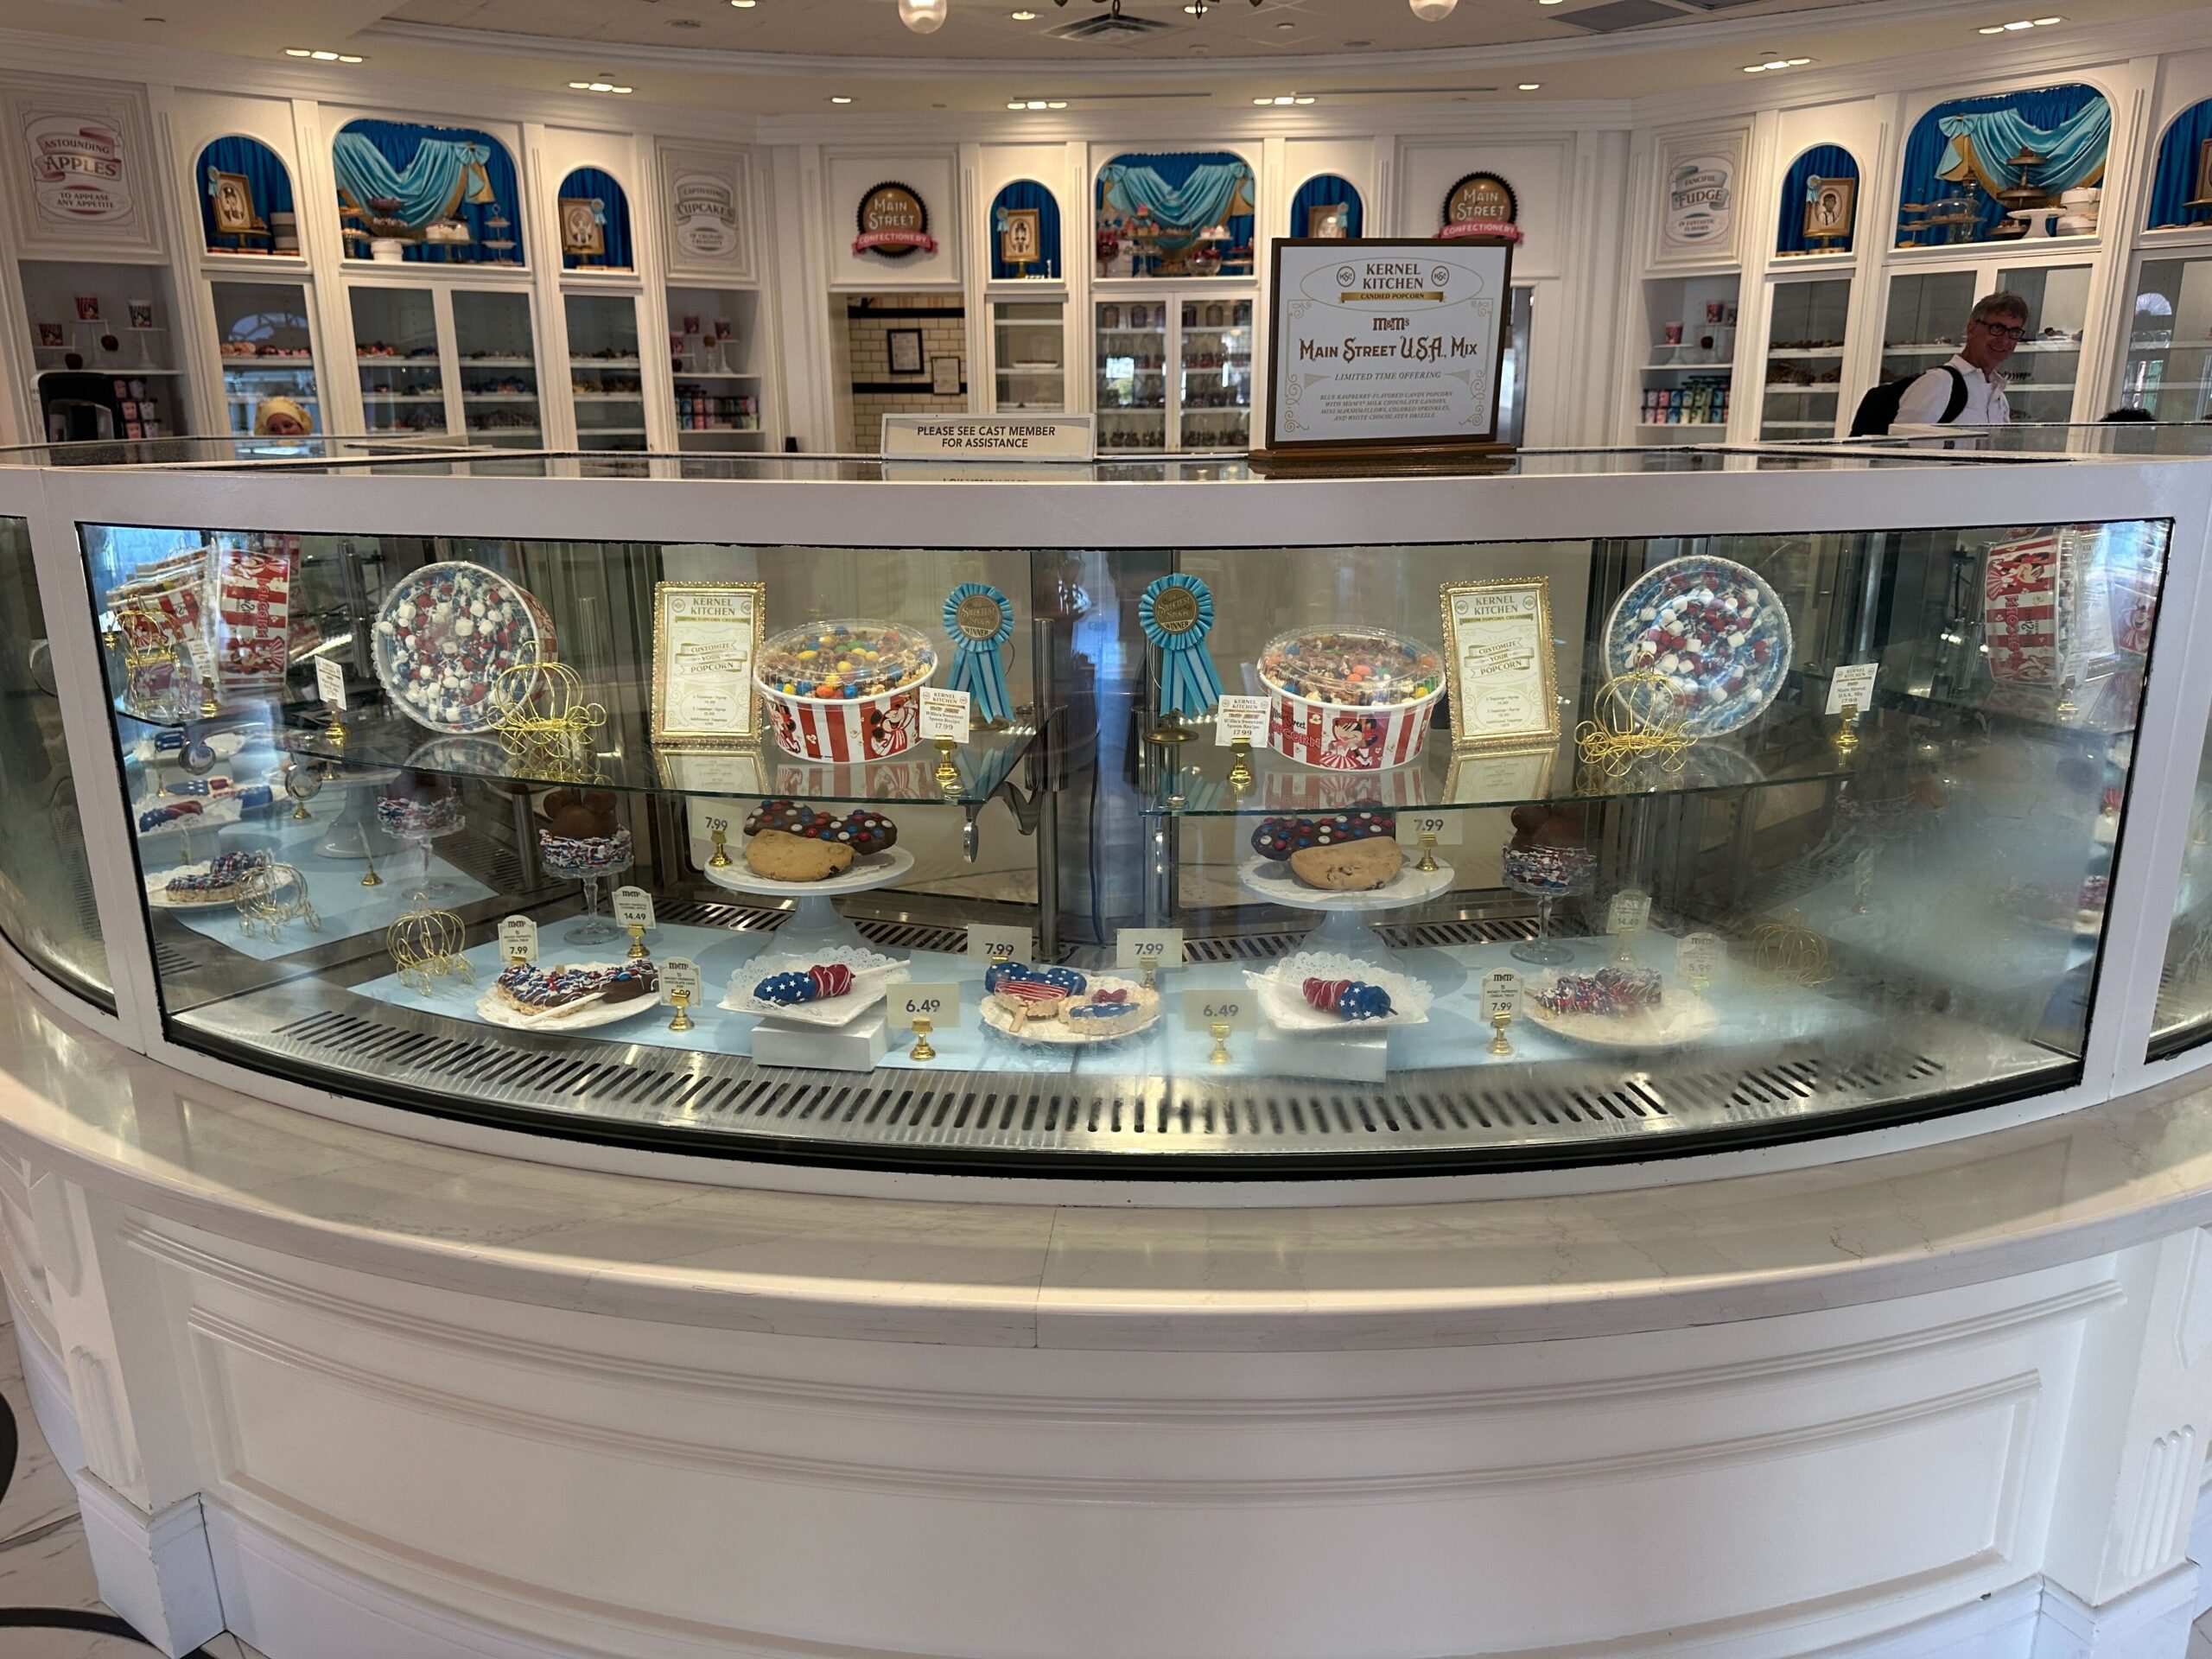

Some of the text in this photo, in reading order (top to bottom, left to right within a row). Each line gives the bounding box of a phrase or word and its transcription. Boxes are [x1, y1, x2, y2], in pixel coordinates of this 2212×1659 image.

[44, 139, 110, 154] ASTOUNDING
[43, 156, 117, 176] APPLES
[1679, 189, 1724, 207] FUDGE
[1443, 224, 1516, 236] CONFECTIONERY
[859, 233, 928, 244] CONFECTIONERY
[1367, 264, 1421, 275] KERNEL
[1363, 278, 1423, 289] KITCHEN
[917, 426, 1055, 435] PLEASE SEE CAST MEMBER
[942, 438, 1028, 448] FOR ASSISTANCE
[1475, 595, 1515, 605] KERNEL
[690, 607, 735, 615] KITCHEN
[1474, 605, 1518, 615] KITCHEN
[965, 627, 988, 636] WINNER
[1166, 621, 1189, 631] WINNER
[691, 643, 729, 653] CUSTOMIZE
[1478, 641, 1516, 655] CUSTOMIZE
[1490, 653, 1509, 662] YOUR
[691, 662, 734, 672] POPCORN
[1480, 660, 1522, 675] POPCORN
[705, 817, 728, 830] 7.99
[1414, 819, 1444, 830] 7.99
[985, 943, 1014, 956] 7.99
[1135, 944, 1164, 955] 7.99
[906, 999, 940, 1013] 6.49
[1203, 1004, 1238, 1017] 6.49
[1491, 1002, 1512, 1011] 7.99
